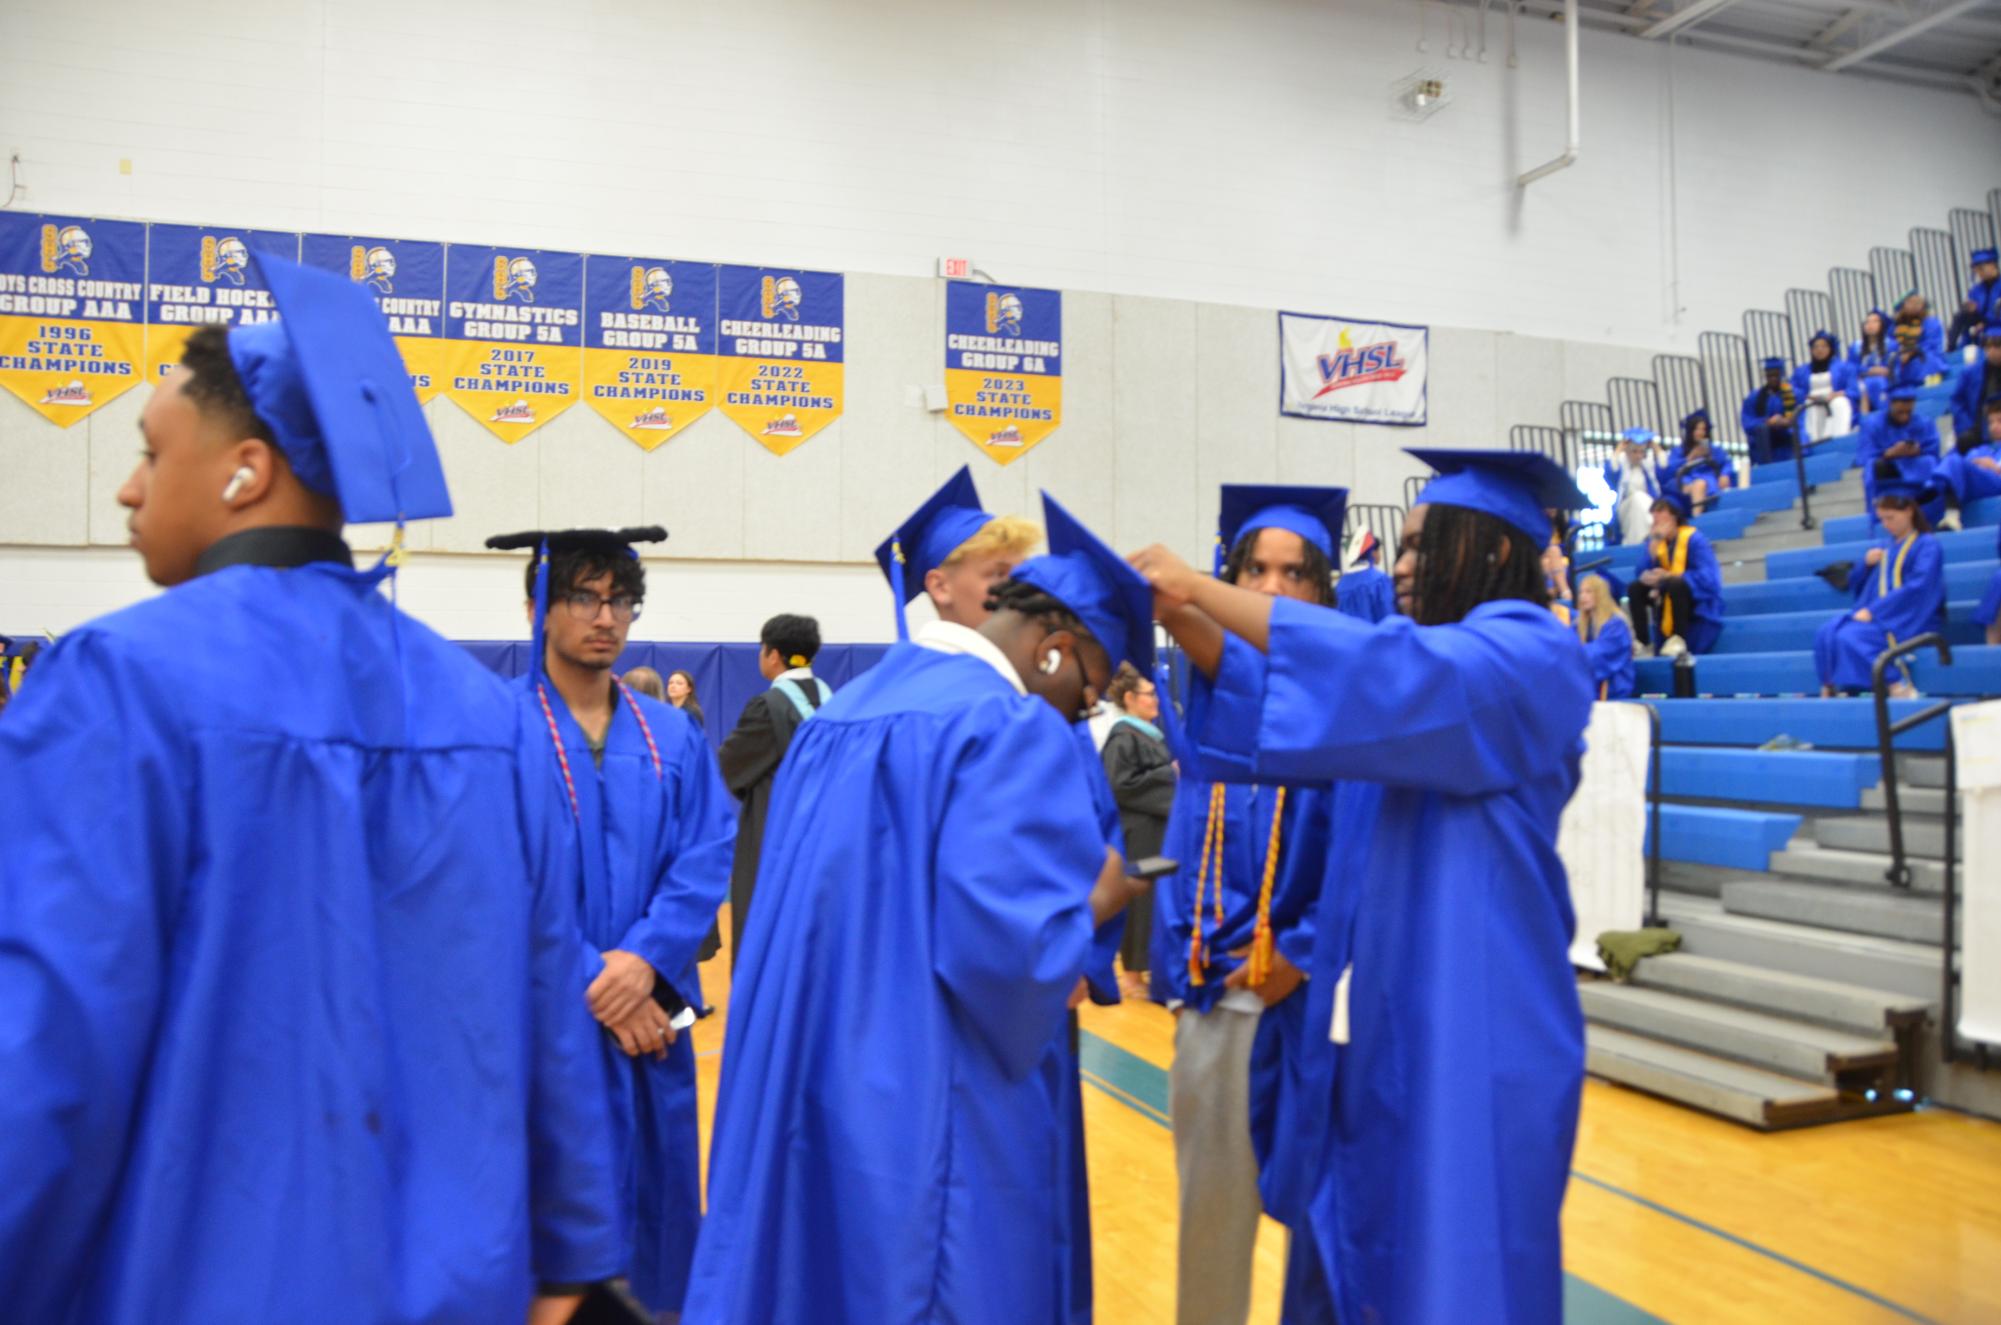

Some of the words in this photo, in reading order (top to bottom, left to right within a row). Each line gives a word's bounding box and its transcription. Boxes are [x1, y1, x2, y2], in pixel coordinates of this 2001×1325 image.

[946, 258, 968, 277] EXIT
[0, 274, 26, 293] OYS
[28, 276, 75, 296] CROSS
[77, 279, 142, 301] COUNTRY
[149, 284, 210, 304] FIELD
[216, 288, 276, 307] HOCK
[0, 294, 77, 316] GROUP
[82, 299, 132, 320] AAA
[160, 304, 234, 323] GROUP
[382, 297, 440, 316] COUNTRY
[449, 301, 578, 325] GYMNASTICS
[388, 316, 432, 334] AAA
[464, 321, 531, 341] GROUP
[537, 325, 562, 342] 5A
[601, 312, 700, 333] BASEBALL
[720, 319, 841, 343] CHEERLEADING
[39, 326, 92, 341] 1996
[603, 330, 668, 349] GROUP
[673, 334, 698, 351] 5A
[27, 341, 104, 358] STATE
[735, 338, 798, 357] GROUP
[802, 342, 827, 359] 5A
[948, 334, 1059, 357] CHEERLEADING
[0, 356, 131, 375] CHAMPIONS
[491, 349, 535, 363] 2017
[629, 357, 672, 371] 2019
[961, 352, 1019, 371] GROUP
[1317, 342, 1404, 384] VHSL
[480, 363, 545, 378] STATE
[618, 371, 681, 386] STATE
[758, 365, 803, 379] 2022
[454, 377, 570, 395] CHAMPIONS
[594, 385, 705, 402] CHAMPIONS
[751, 379, 811, 393] STATE
[983, 378, 1025, 391] 2023
[727, 392, 833, 409] CHAMPIONS
[976, 392, 1032, 405] STATE
[954, 404, 1053, 420] CHAMPIONS
